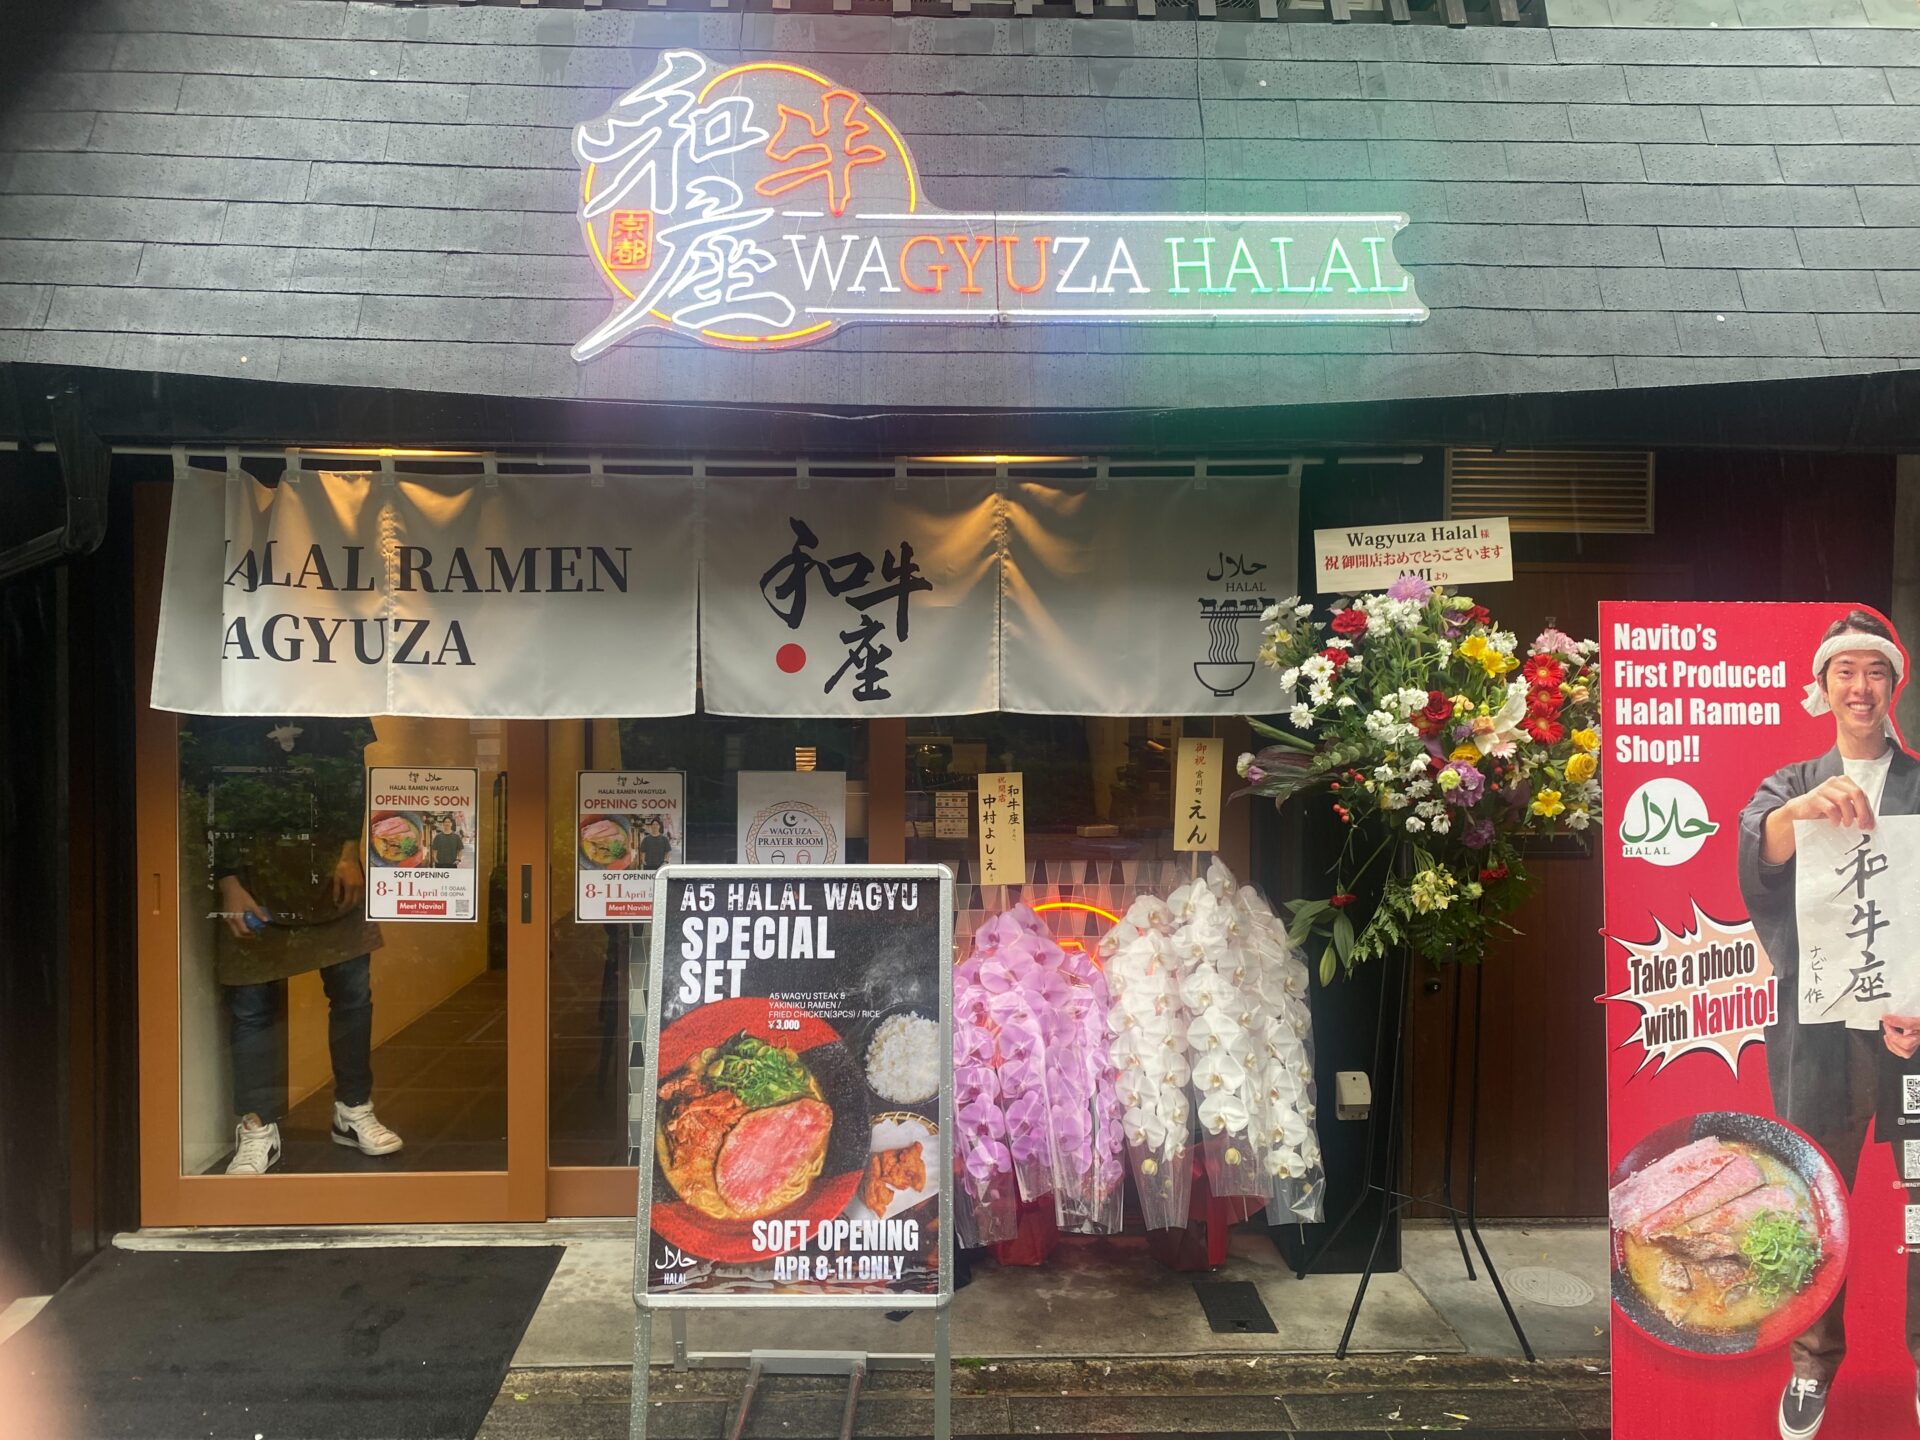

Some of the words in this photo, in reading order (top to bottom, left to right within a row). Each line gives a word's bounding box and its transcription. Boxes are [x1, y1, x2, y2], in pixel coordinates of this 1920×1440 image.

[613, 216, 647, 267] 京都
[783, 234, 1151, 294] WAGYUZA
[1164, 237, 1408, 294] HALAL
[1346, 532, 1426, 549] Wagyuza
[1431, 525, 1478, 542] Halal
[224, 539, 375, 593] ALAL
[394, 545, 632, 594] RAMEN
[1206, 551, 1267, 581] حلال
[1324, 555, 1339, 571] 祝
[1226, 582, 1267, 592] HALAL
[222, 612, 476, 666] AGYUZA
[1614, 623, 1718, 651] Navito's
[1614, 660, 1668, 689] First
[1672, 660, 1787, 689] Produced
[1615, 697, 1683, 726] Halal
[1689, 697, 1781, 726] Ramen
[1615, 734, 1700, 766] Shop!!
[375, 794, 430, 806] OPENING
[433, 795, 470, 807] SOON
[584, 798, 638, 809] OPENING
[641, 798, 677, 809] SOON
[1007, 784, 1020, 825] 和牛座
[1187, 799, 1207, 845] えん
[1622, 790, 1718, 843] حلال
[758, 837, 793, 846] PRAYER
[796, 837, 824, 846] ROOM
[770, 827, 813, 835] WAGYUZA
[982, 794, 997, 872] 中村よしえ
[1624, 846, 1671, 856] HALAL
[393, 871, 412, 879] SOFT
[414, 871, 450, 879] OPENING
[399, 902, 417, 910] Meet
[419, 902, 445, 911] Navito!
[416, 889, 438, 899] April
[625, 890, 646, 900] April
[680, 883, 716, 912] A5
[728, 883, 813, 911] HALAL
[823, 882, 919, 911] WAGYU
[680, 916, 836, 960] SPECIAL
[1820, 834, 1892, 1017] 和牛座
[679, 959, 747, 1004] SET
[1630, 952, 1677, 996] Take
[1682, 954, 1694, 986] a
[1699, 941, 1755, 987] photo
[769, 992, 780, 1000] A5
[781, 992, 812, 1000] WAGYU
[813, 992, 839, 1000] STEAK
[769, 1001, 806, 1009] YAKINIKU
[807, 1001, 837, 1009] RAMEN
[768, 1010, 792, 1018] FRIED
[862, 1010, 881, 1018] RICE
[1644, 1004, 1689, 1047] with
[1692, 979, 1776, 1039] Navito!
[752, 1219, 810, 1252] SOFT
[817, 1219, 919, 1252] OPENING
[655, 1245, 698, 1270] حلال
[773, 1255, 810, 1281] APR
[815, 1255, 852, 1281] 8-11
[858, 1255, 905, 1281] ONLY
[663, 1272, 688, 1285] HALAL
